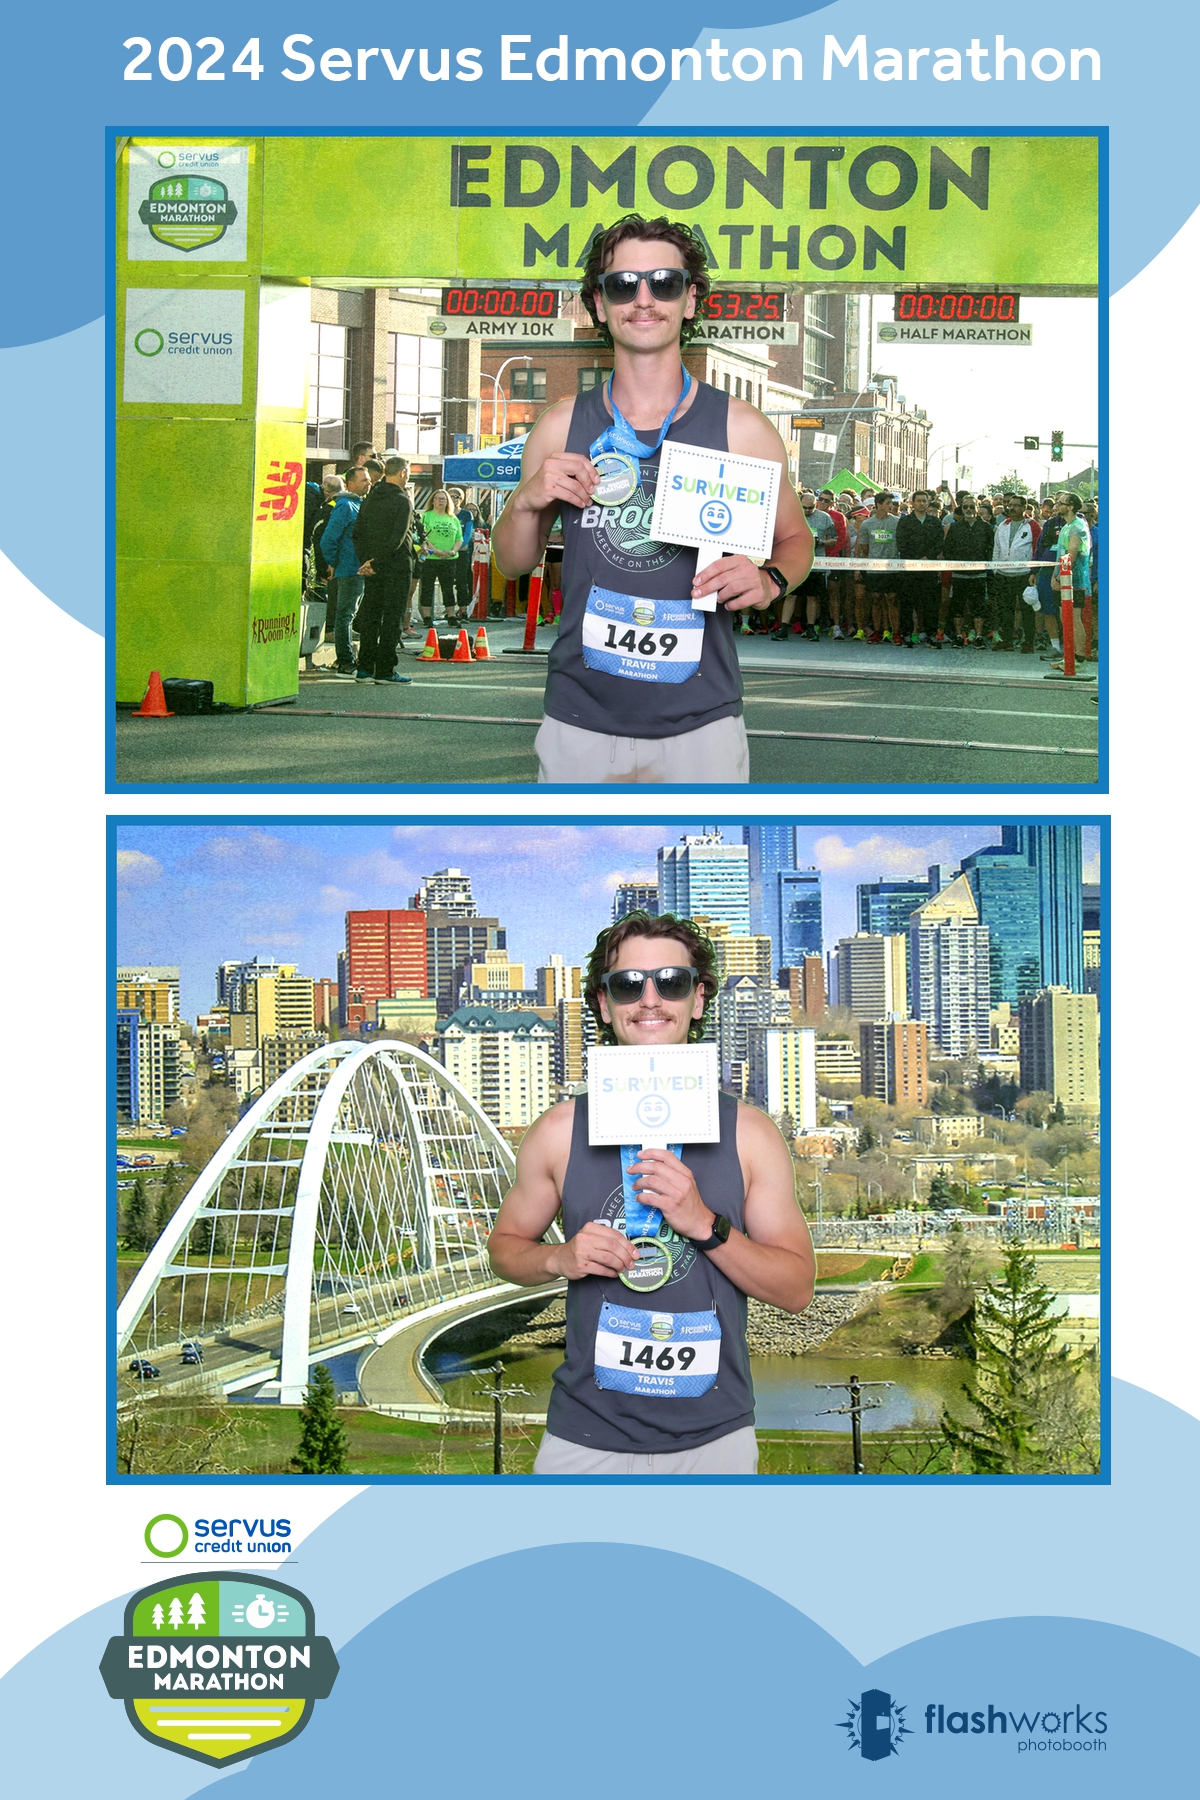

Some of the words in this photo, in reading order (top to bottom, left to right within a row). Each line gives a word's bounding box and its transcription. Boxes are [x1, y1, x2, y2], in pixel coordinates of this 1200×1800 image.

[178, 153, 219, 161] servus
[450, 145, 990, 211] EDMONTON
[150, 203, 226, 213] EDMONTON
[160, 214, 215, 222] MARATHON
[523, 223, 906, 271] MAATHON
[465, 321, 517, 335] ARMY
[521, 322, 554, 336] 10K
[695, 326, 785, 340] ARATHON
[900, 328, 939, 340] HALF
[943, 329, 1031, 341] MARATHON
[168, 332, 232, 345] servus
[168, 345, 200, 355] credit
[203, 347, 232, 355] union
[496, 465, 521, 475] ser
[718, 463, 725, 479] I
[671, 475, 765, 506] SURVIVED!
[596, 530, 612, 554] MEET
[611, 553, 625, 565] ME
[627, 560, 642, 568] ON
[646, 555, 666, 567] THE
[257, 613, 290, 640] Running
[604, 623, 678, 657] 1469
[620, 657, 657, 671] TRAVIS
[617, 668, 658, 680] MARATHON
[650, 1057, 655, 1072] I
[602, 1075, 703, 1093] SURVIVED!
[619, 1341, 696, 1371] 1469
[637, 1375, 675, 1386] TRAVIS
[634, 1386, 676, 1396] MARATHON
